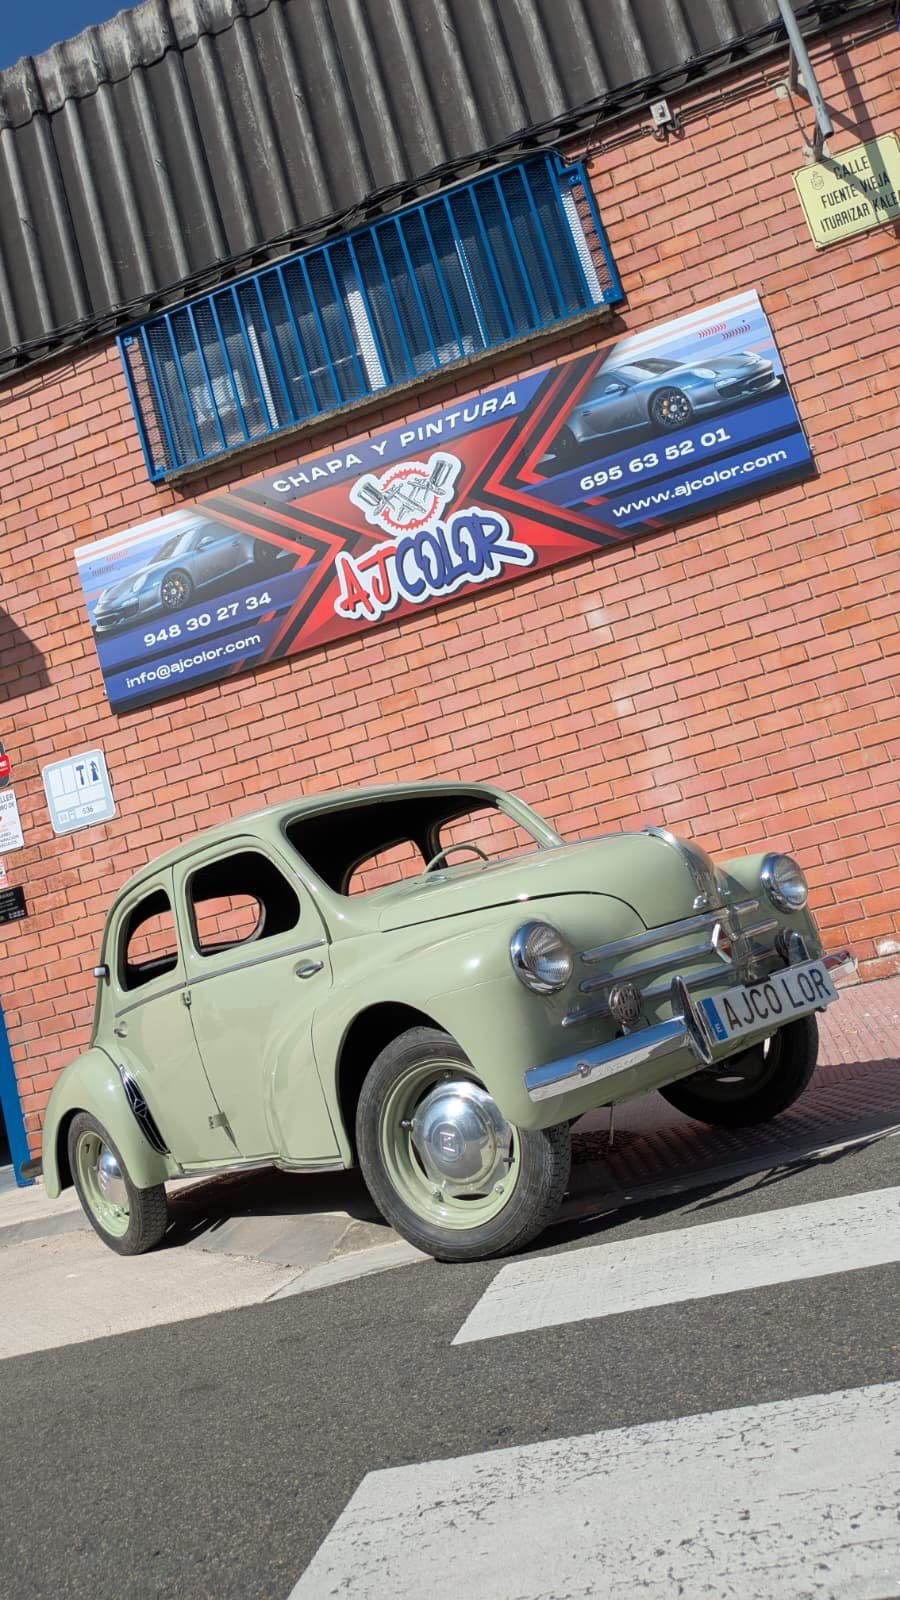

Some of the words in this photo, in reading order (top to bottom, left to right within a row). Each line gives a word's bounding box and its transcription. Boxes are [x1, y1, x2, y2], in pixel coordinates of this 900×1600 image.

[820, 184, 859, 209] FUENTE
[860, 171, 891, 193] VIEJA
[833, 156, 870, 180] CALLE
[820, 202, 871, 233] ITURRIZAR
[872, 189, 900, 212] KALE
[272, 453, 363, 493] CHAPA
[370, 440, 388, 455] Y
[400, 391, 517, 448] PINTURA
[579, 465, 624, 491] 695
[628, 453, 659, 473] 63
[664, 439, 695, 461] 52
[700, 427, 731, 447] 01
[612, 448, 788, 518] www.ajcolor.com
[143, 624, 182, 648] 948
[186, 613, 211, 632] 30
[216, 603, 239, 622] 27
[245, 591, 272, 610] 34
[125, 633, 262, 689] info@ajcolor.com
